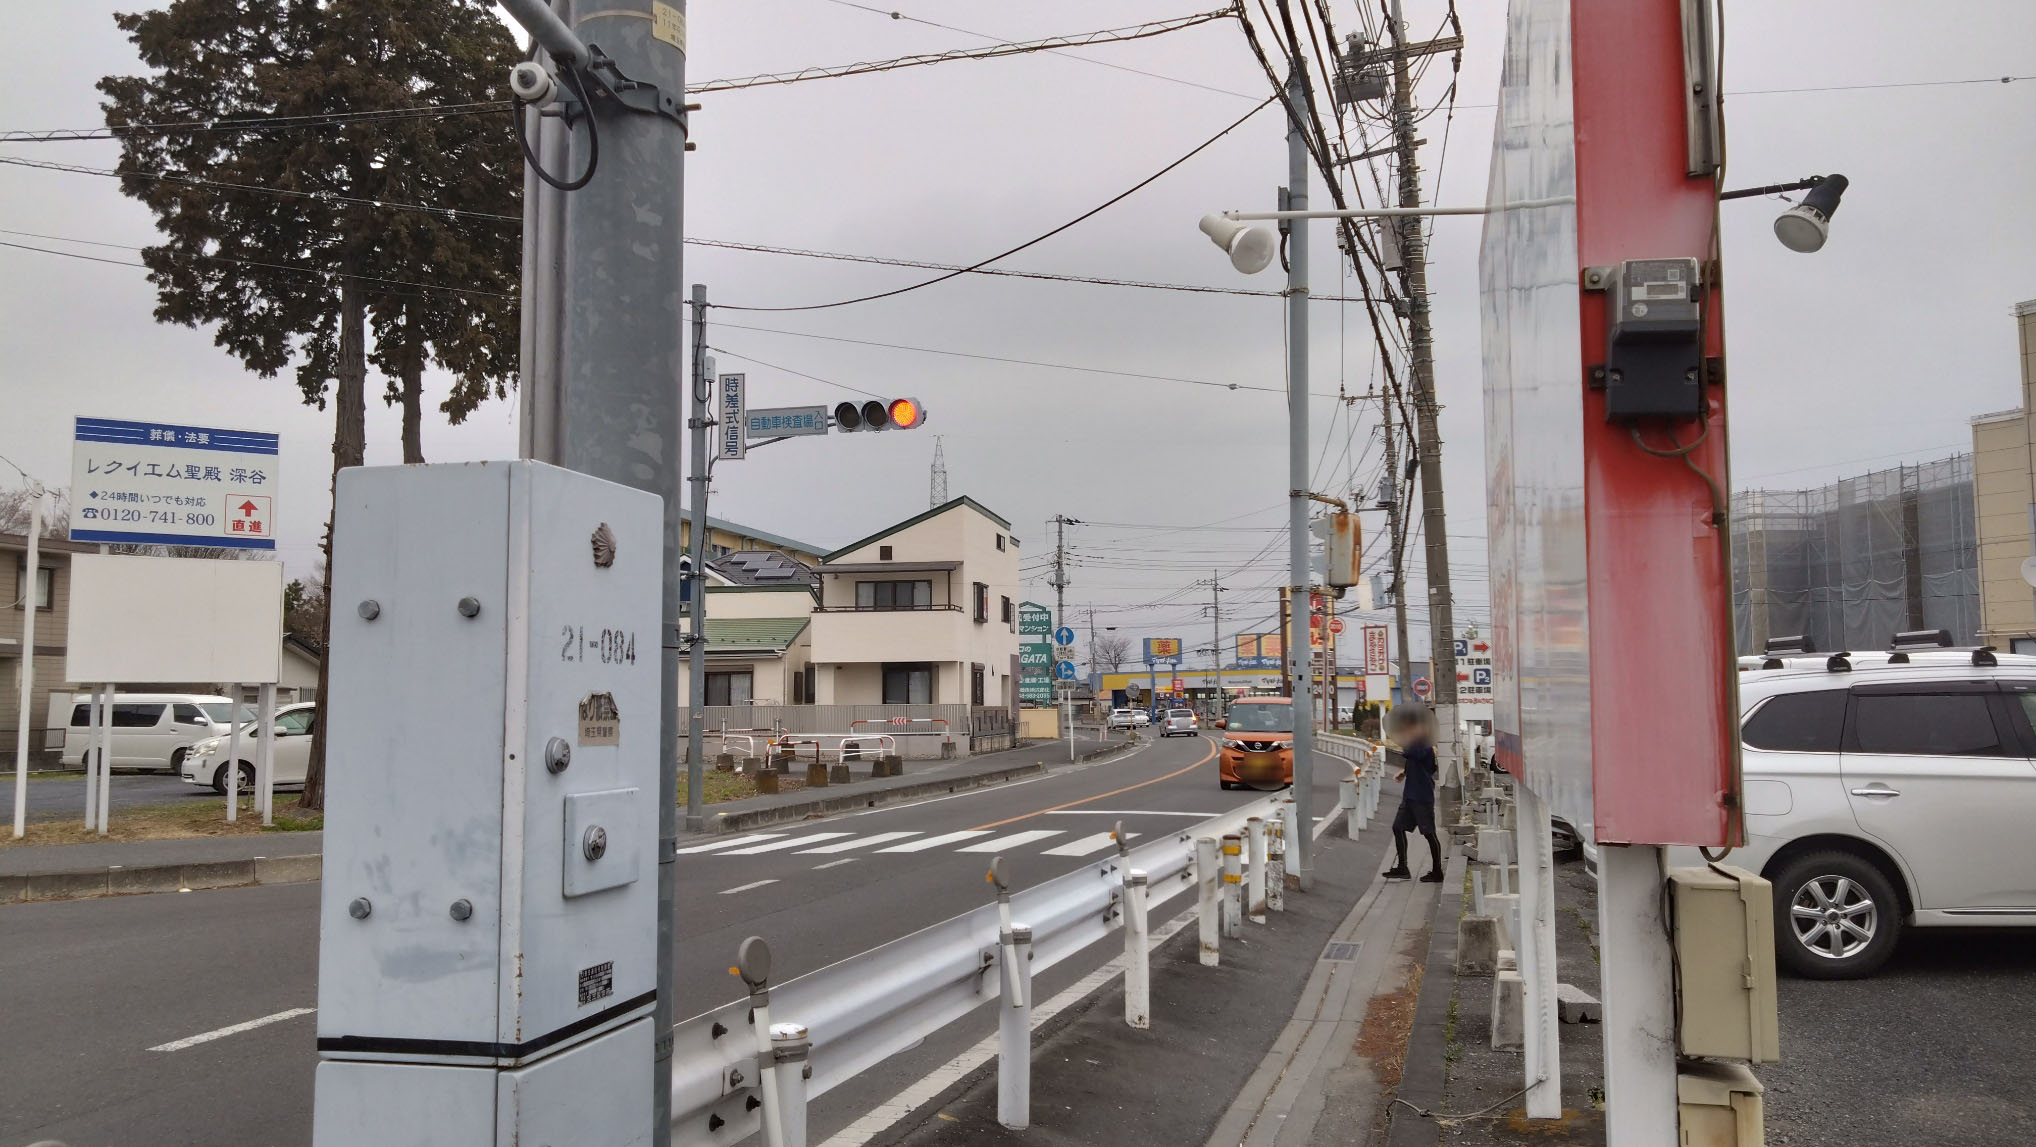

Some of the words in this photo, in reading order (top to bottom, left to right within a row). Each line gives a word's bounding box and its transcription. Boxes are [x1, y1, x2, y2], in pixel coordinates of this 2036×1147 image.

[725, 377, 739, 456] 時差式信号
[149, 429, 210, 445] 葬儀・法要
[87, 458, 222, 482] レクイエム聖殿
[229, 468, 266, 484] 深谷
[101, 508, 215, 526] 0120-741-800
[232, 519, 262, 533] 直進
[561, 624, 636, 665] 21-084
